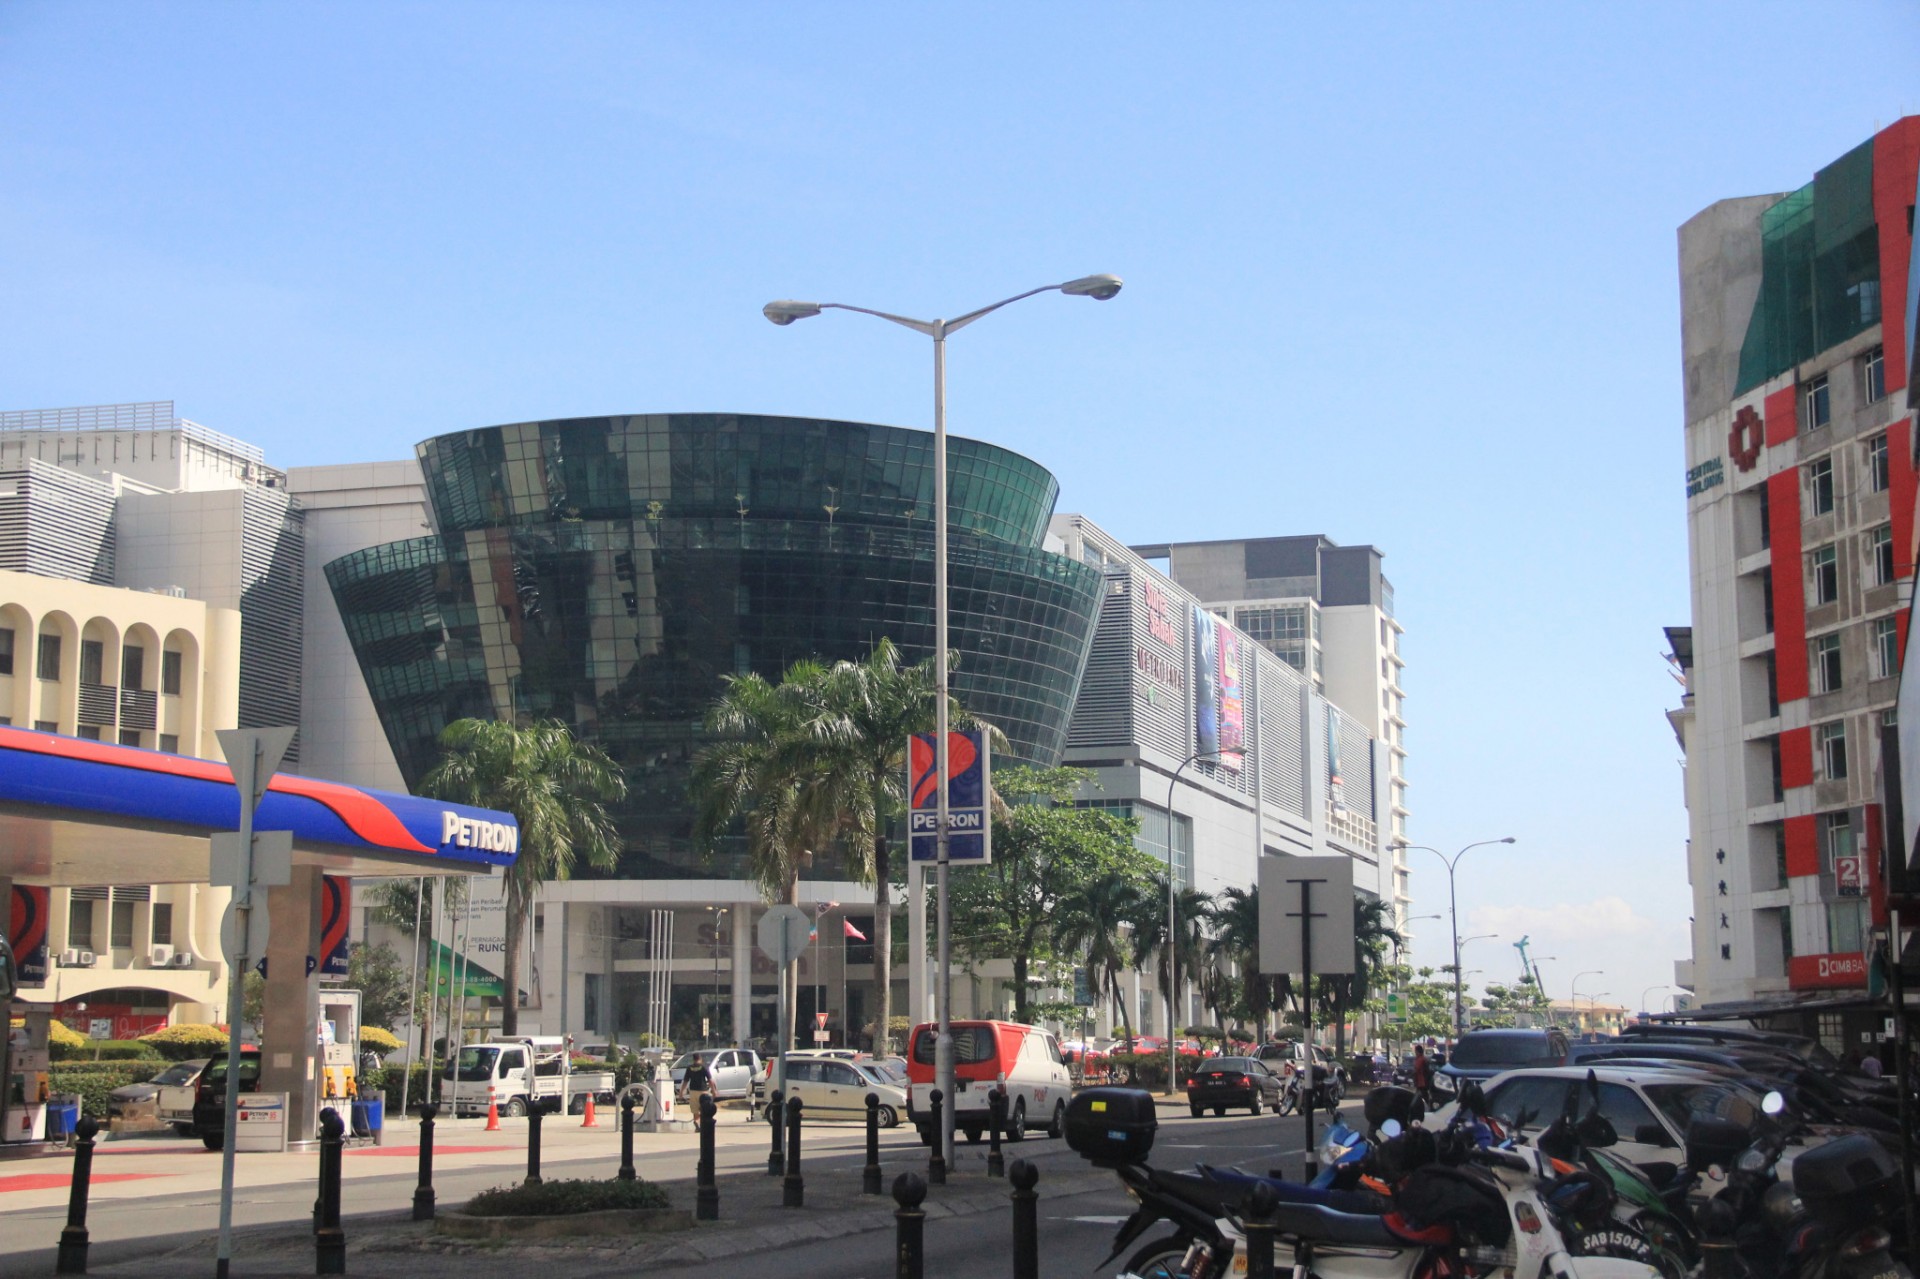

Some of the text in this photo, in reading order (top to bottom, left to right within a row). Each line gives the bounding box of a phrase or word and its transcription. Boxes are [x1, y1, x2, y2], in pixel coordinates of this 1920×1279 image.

[913, 814, 980, 829] PERON
[442, 811, 517, 853] PETRON
[1830, 959, 1865, 974] CIMB BA
